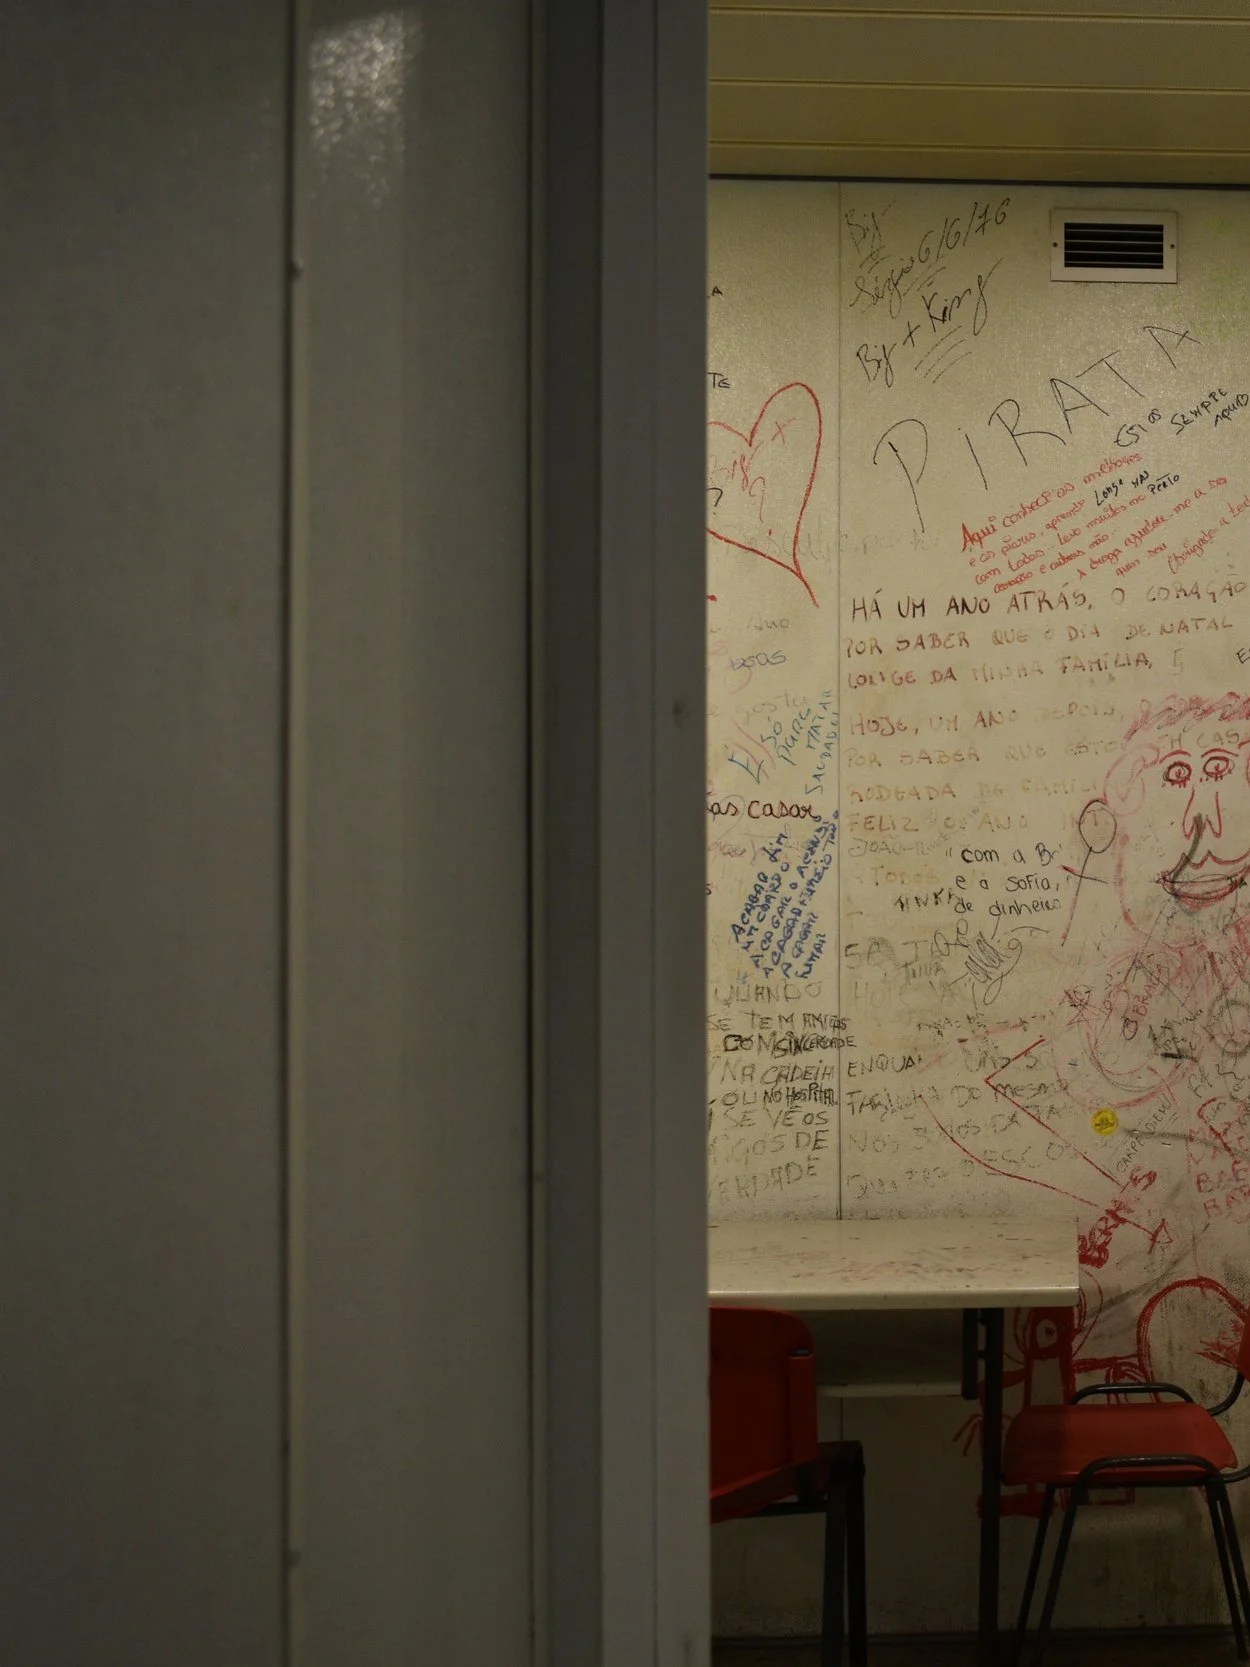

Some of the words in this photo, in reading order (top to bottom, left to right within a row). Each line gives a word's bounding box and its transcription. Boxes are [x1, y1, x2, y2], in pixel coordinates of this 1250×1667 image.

[851, 587, 883, 624] HÁ
[897, 595, 927, 619] UM
[944, 594, 991, 618] ANO
[1159, 615, 1234, 637] NATAL
[929, 664, 958, 686] DA
